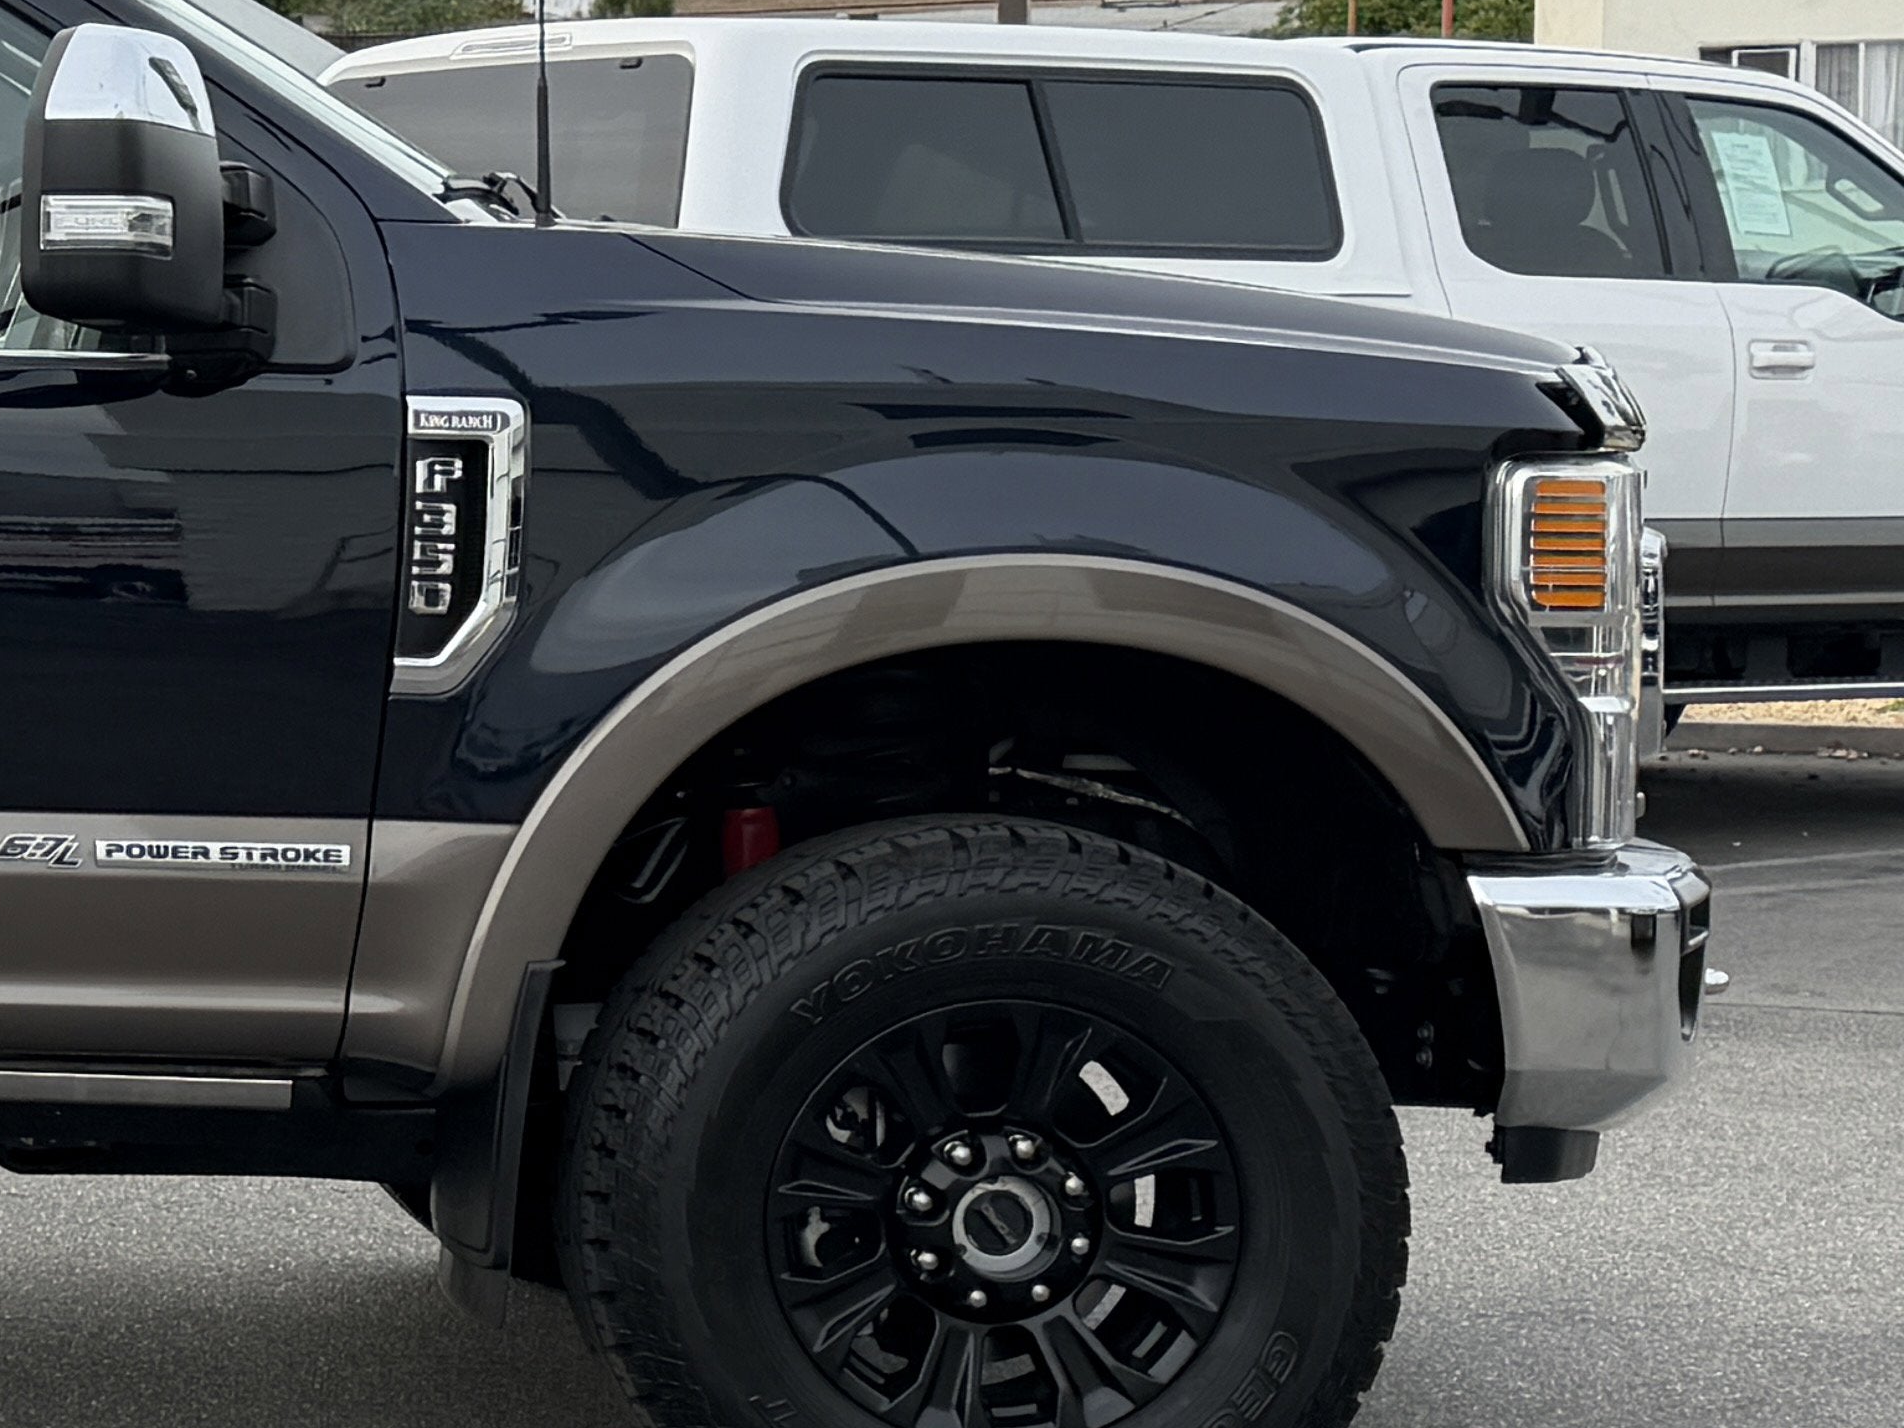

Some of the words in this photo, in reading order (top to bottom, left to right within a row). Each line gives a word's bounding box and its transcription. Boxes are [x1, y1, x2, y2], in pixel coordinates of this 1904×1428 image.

[420, 413, 450, 428] KING
[451, 414, 494, 429] RANCH
[105, 842, 211, 860] POWER
[218, 846, 343, 864] STROKE
[789, 923, 1175, 1025] YOKOHAMA
